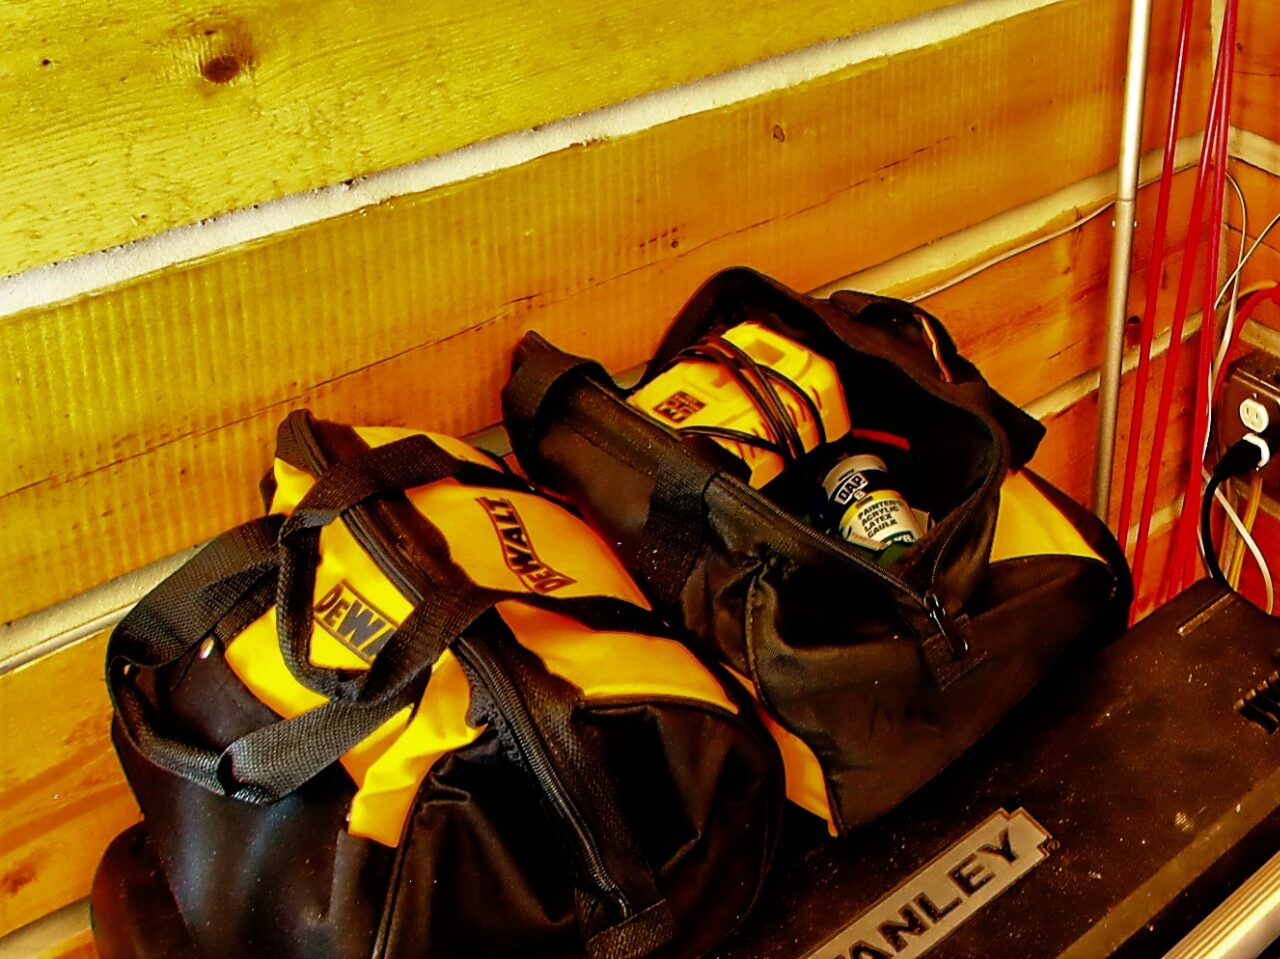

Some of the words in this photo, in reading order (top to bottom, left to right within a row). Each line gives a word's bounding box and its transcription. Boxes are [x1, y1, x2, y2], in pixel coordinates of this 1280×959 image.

[837, 475, 863, 501] DAP
[864, 513, 892, 532] LATEX
[867, 519, 898, 538] CAULK
[486, 496, 567, 592] DEWALT
[848, 828, 1019, 959] ANLEY
